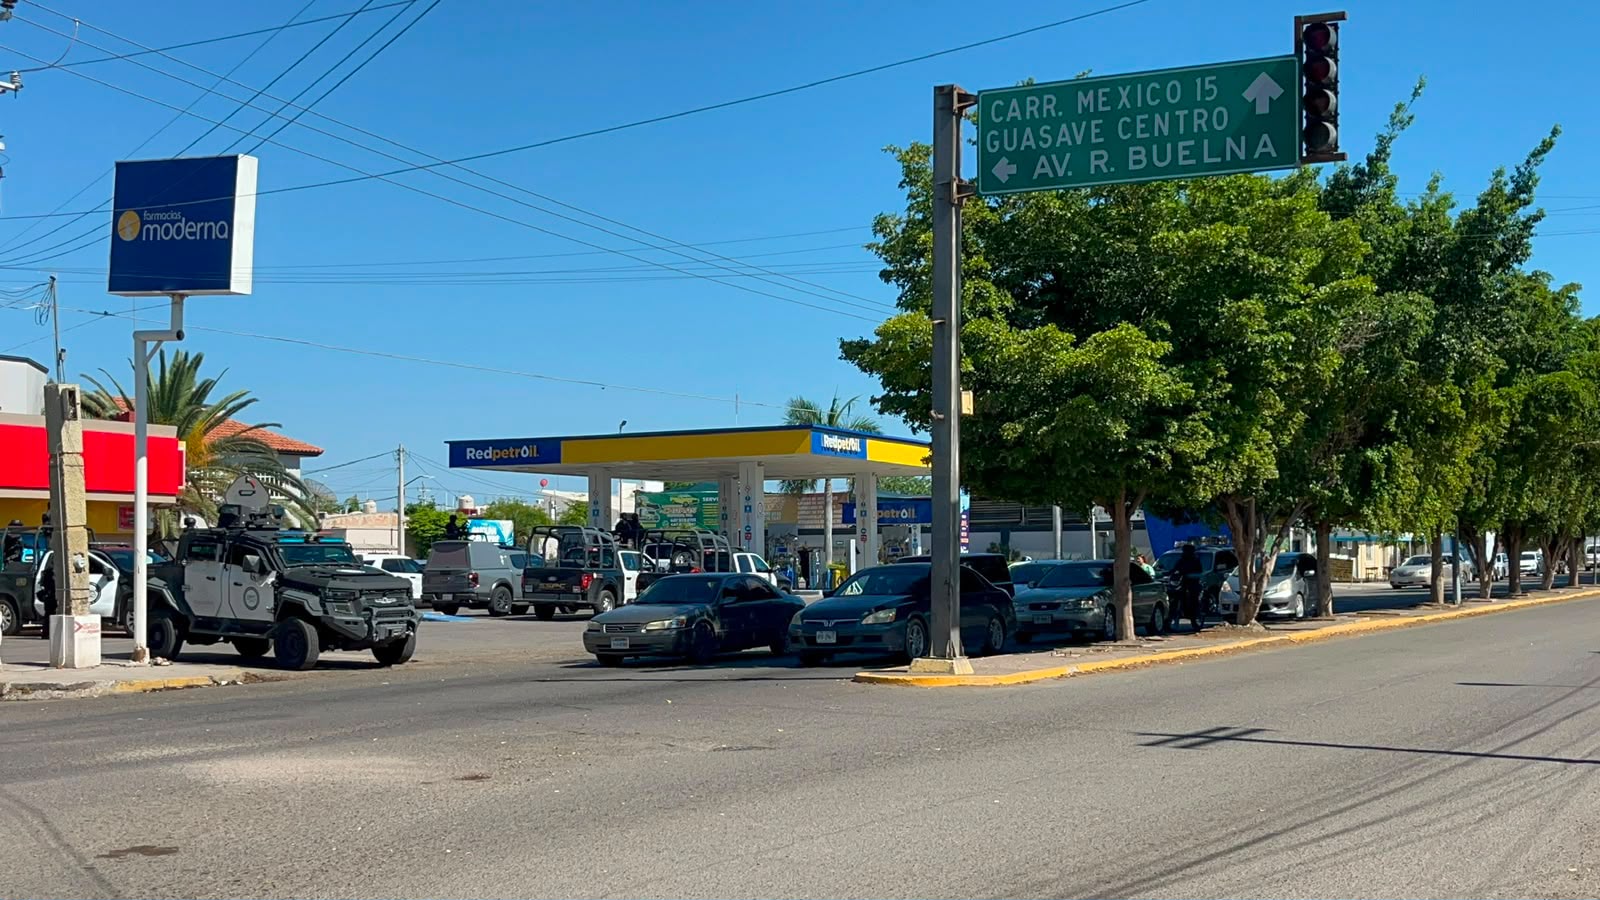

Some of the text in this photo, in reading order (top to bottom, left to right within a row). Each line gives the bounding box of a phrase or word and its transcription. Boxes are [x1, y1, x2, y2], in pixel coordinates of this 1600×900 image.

[991, 76, 1218, 123] CARR. MEXICO 15
[986, 106, 1229, 153] GUASAVE CENTRO
[1032, 134, 1277, 179] AV. R. BUELNA
[142, 217, 229, 241] moderna
[143, 210, 183, 221] farmacias
